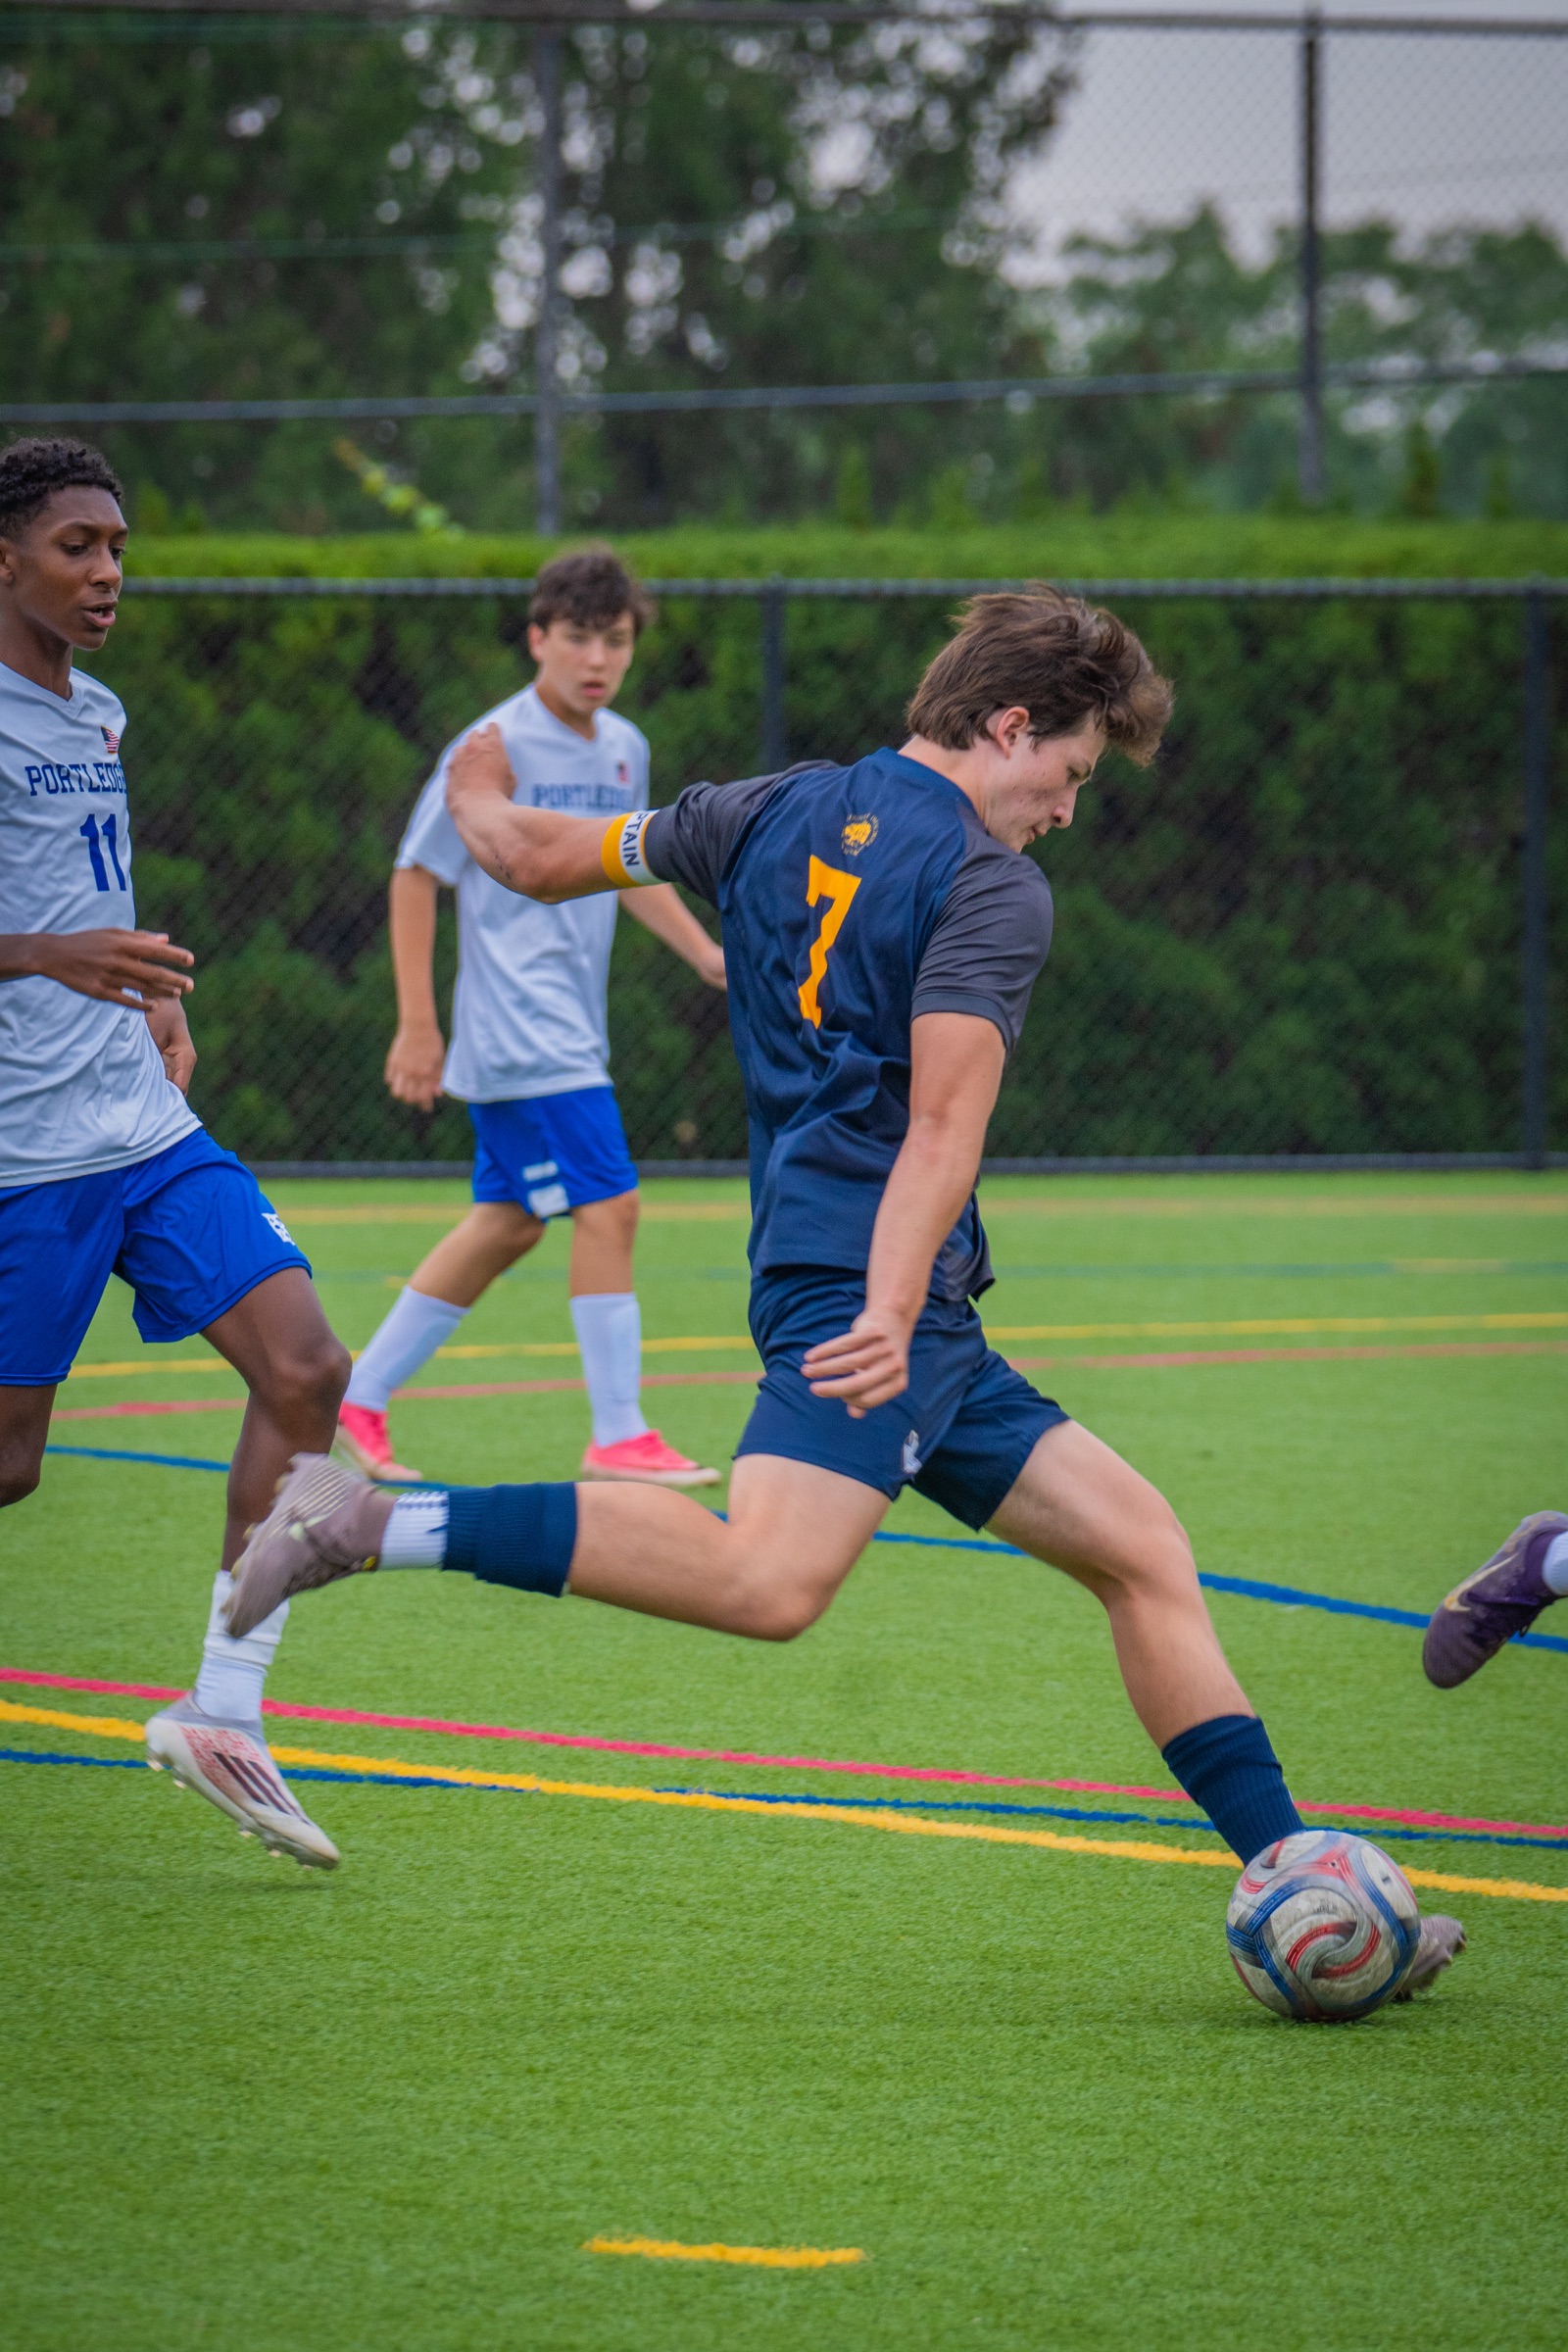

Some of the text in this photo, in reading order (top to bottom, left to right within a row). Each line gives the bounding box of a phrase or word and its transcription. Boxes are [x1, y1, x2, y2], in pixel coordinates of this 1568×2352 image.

[24, 762, 127, 796] PORTLEDG
[79, 813, 126, 892] 11
[798, 854, 862, 1030] 7
